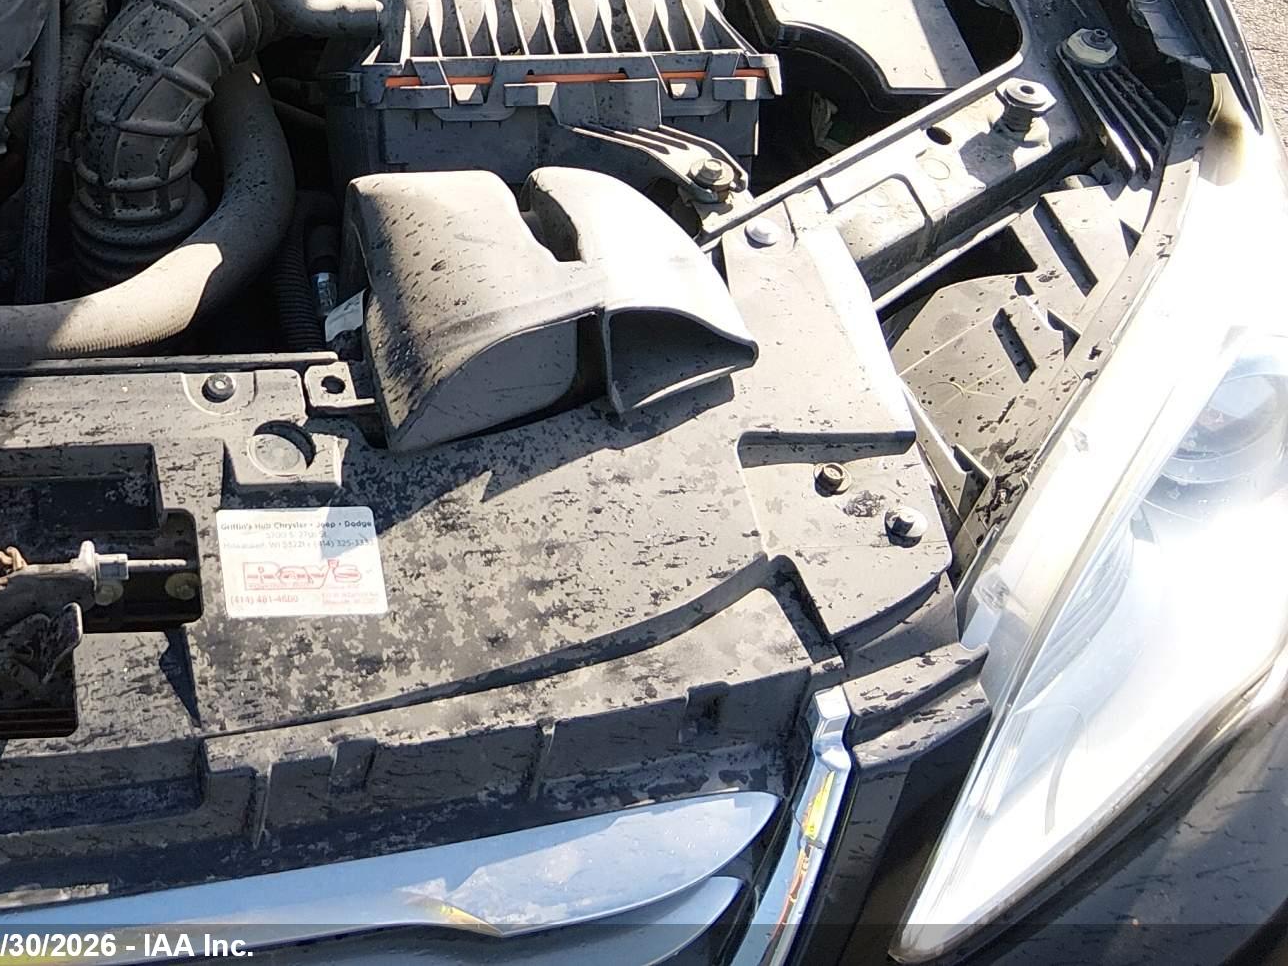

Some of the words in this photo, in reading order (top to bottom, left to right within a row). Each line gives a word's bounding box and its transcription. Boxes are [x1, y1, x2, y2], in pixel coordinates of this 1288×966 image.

[273, 521, 308, 531] Chrysler
[316, 520, 336, 530] Jeep
[343, 519, 373, 529] Dodge
